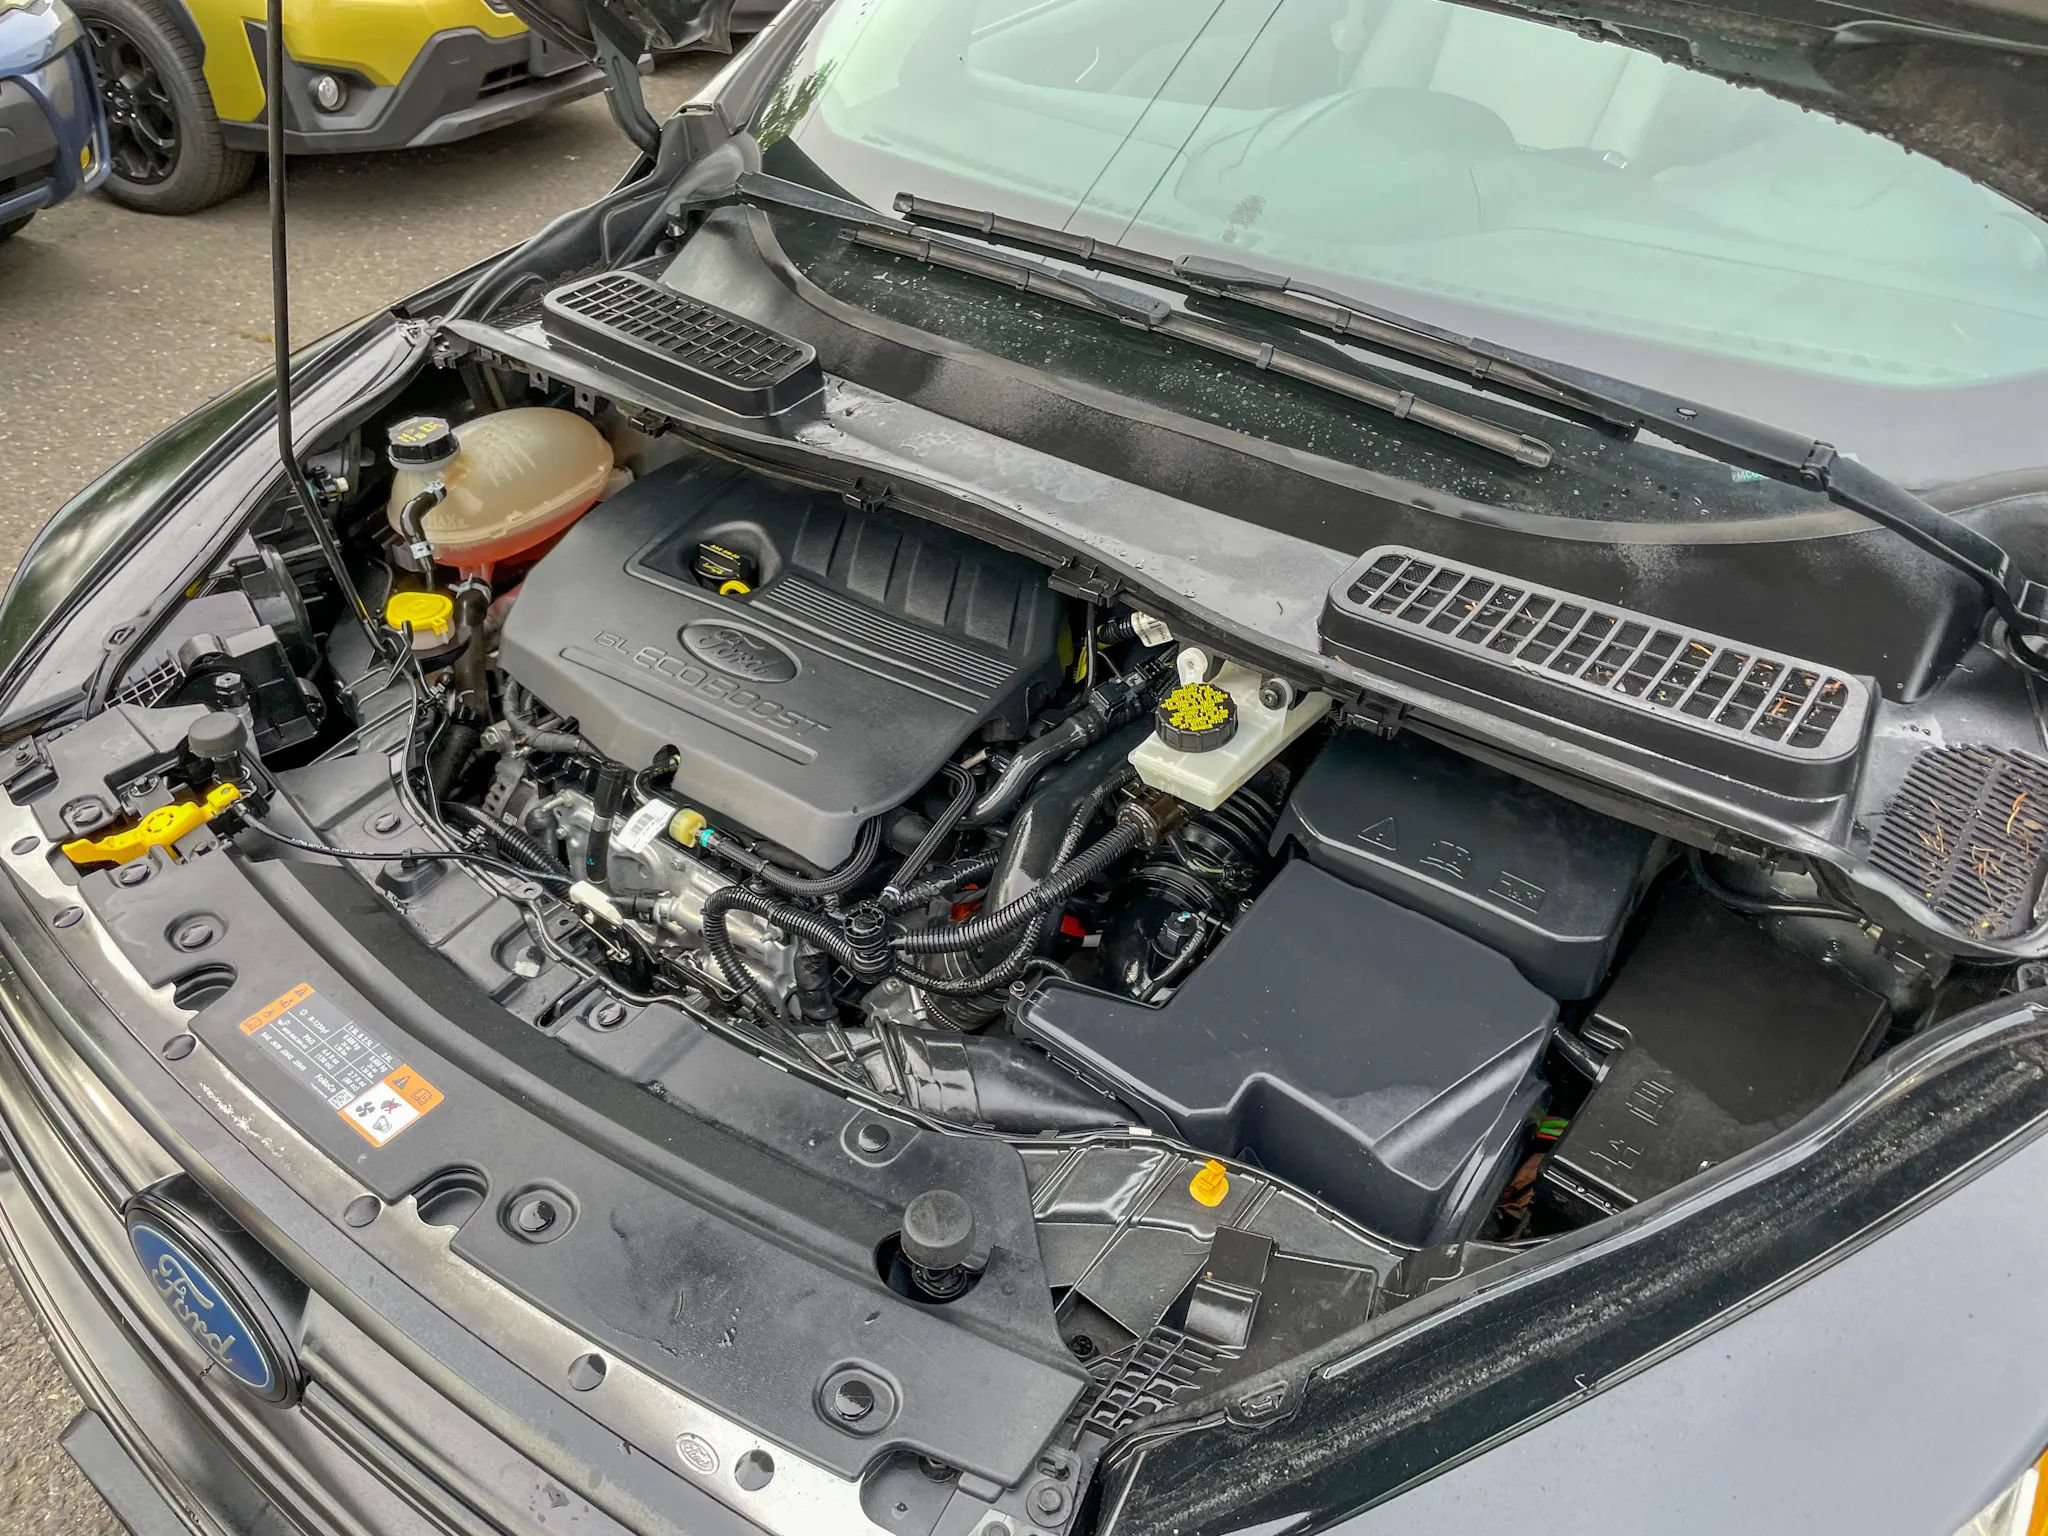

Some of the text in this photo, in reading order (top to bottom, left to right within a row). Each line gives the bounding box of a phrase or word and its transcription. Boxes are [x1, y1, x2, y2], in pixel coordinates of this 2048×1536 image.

[695, 630, 778, 675] Ford
[633, 647, 832, 736] ECOBOOST
[307, 1016, 330, 1034] R-1234yf
[302, 1033, 315, 1045] PAG
[314, 1073, 336, 1092] FoMoCo
[153, 1254, 236, 1364] Ford
[684, 1443, 710, 1467] Ford
